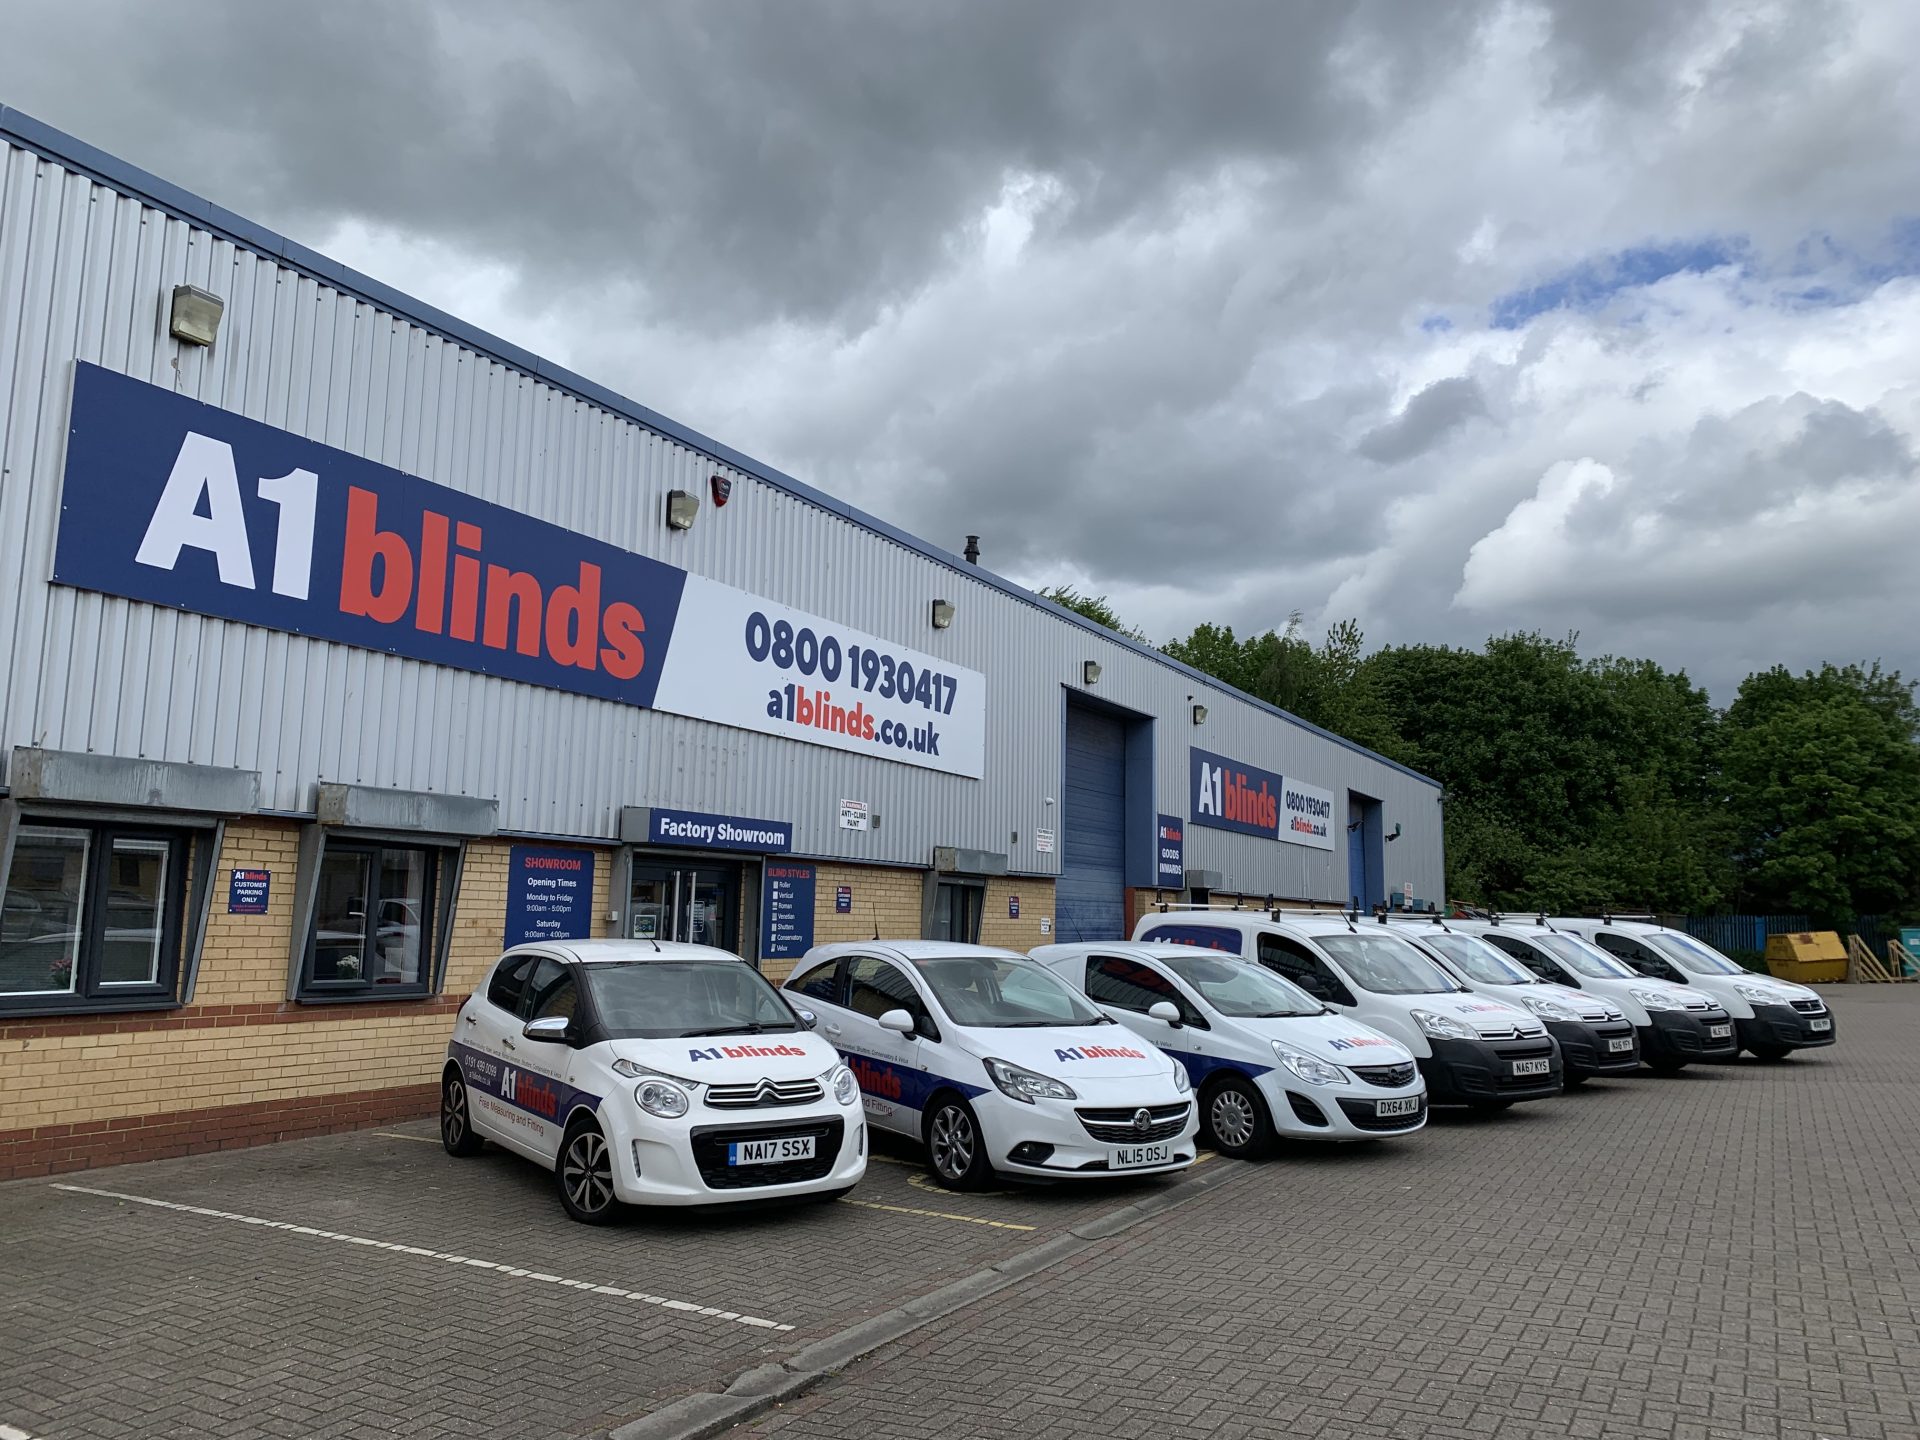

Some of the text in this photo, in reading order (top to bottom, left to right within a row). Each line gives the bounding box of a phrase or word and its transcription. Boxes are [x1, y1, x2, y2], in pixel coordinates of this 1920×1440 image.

[134, 431, 646, 680] A1 blinds
[745, 611, 958, 716] 0800 1930417
[766, 683, 940, 757] a1blinds.co.uk
[1198, 761, 1277, 829] A1 blinds
[1285, 790, 1331, 819] 0800 1930417
[841, 810, 867, 820] ANTI-CLIMB
[660, 817, 786, 846] Factory Showroom
[1290, 815, 1328, 838] a1blinds.co.uk
[1161, 847, 1180, 860] GOODS
[524, 857, 582, 871] SHOWROOM
[1159, 862, 1182, 875] INWARDS
[234, 871, 245, 879] A1
[787, 869, 811, 879] STYLES
[527, 877, 577, 888] Opening Times
[526, 893, 574, 903] Monday to Friday
[526, 904, 547, 912] 9:00am
[536, 920, 561, 929] Saturday
[549, 930, 570, 939] 4:00pm
[777, 934, 803, 942] Conservatory
[688, 1044, 807, 1062] A1 blinds
[1054, 1045, 1146, 1062] A1 blinds
[464, 1054, 476, 1068] 0191
[1516, 1060, 1547, 1074] NA67 KYS
[500, 1066, 558, 1118] A1 blinds
[871, 1099, 893, 1117] Fitting
[1380, 1099, 1417, 1114] DX64 XKJ
[478, 1095, 544, 1137] Free Measuring and Fitting
[743, 1138, 811, 1161] NA17 SSX
[1117, 1146, 1168, 1165] NL15 OSJ
